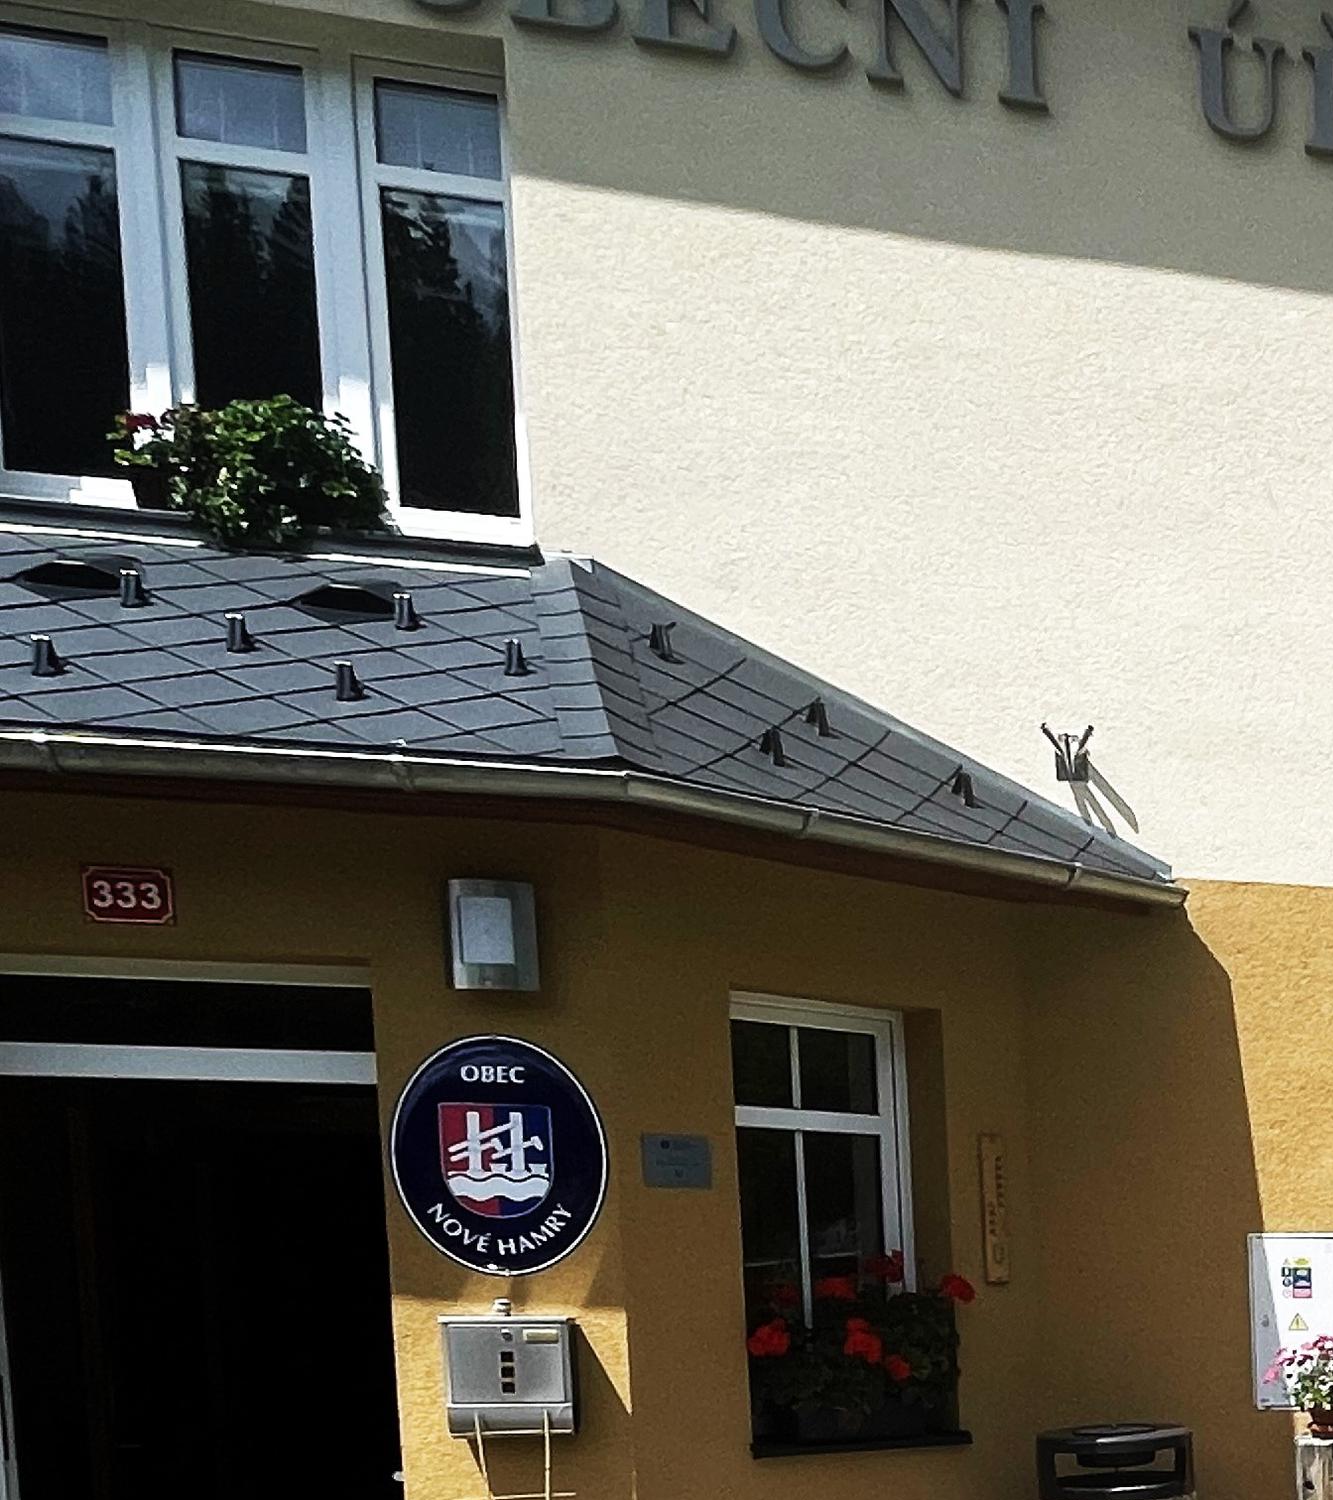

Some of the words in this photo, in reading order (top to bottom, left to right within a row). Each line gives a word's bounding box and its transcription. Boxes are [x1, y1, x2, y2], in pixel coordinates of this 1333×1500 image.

[93, 880, 161, 909] 333
[460, 1065, 525, 1083] OBEC
[427, 1203, 492, 1253] NOVÉ
[497, 1203, 572, 1255] HAMRY
